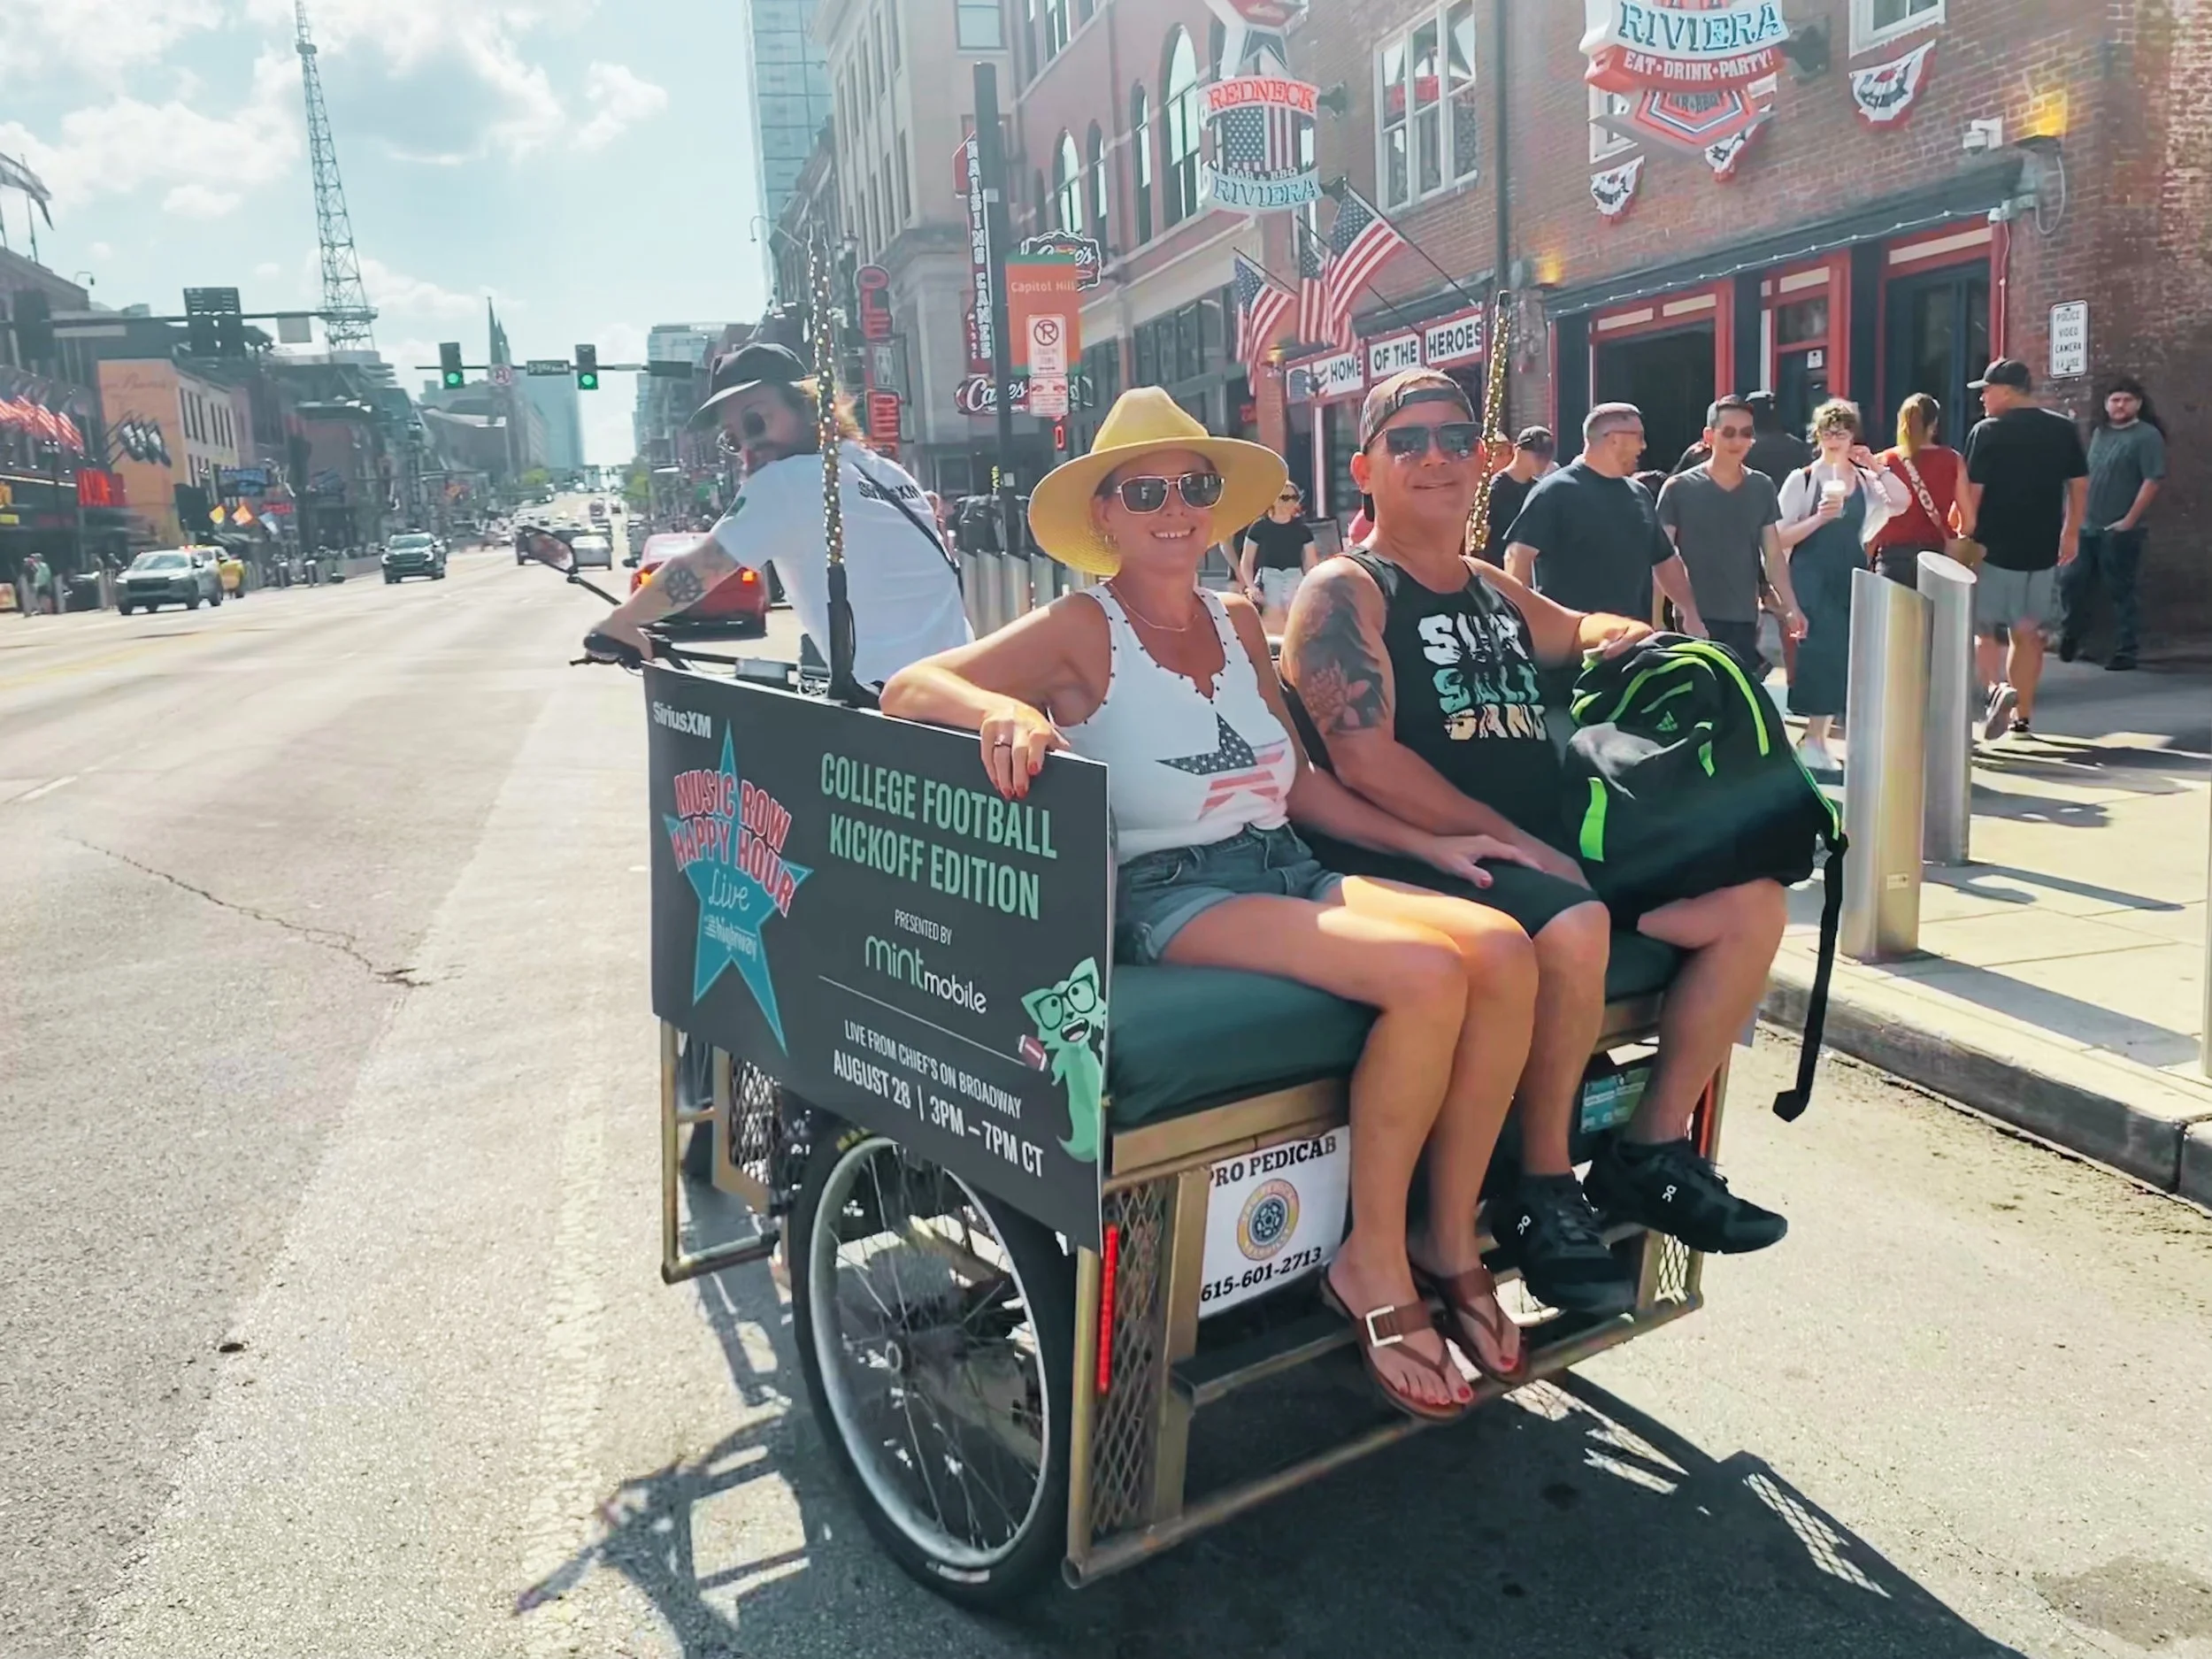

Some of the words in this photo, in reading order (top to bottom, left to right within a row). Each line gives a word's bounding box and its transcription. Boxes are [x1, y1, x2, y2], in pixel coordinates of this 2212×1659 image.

[1618, 2, 1781, 51] RIVIERA
[1623, 50, 1656, 75] EAT
[1663, 60, 1714, 81] DRINK
[1719, 50, 1774, 78] PARTY!
[1208, 80, 1316, 113] REDNECK
[966, 140, 986, 265] RAISING
[1214, 177, 1317, 207] RIVIERA
[1010, 280, 1051, 294] Capitol
[1056, 280, 1075, 292] Hill
[1330, 357, 1362, 383] HOME
[1373, 347, 1389, 372] OF
[1394, 339, 1417, 367] THE
[1427, 320, 1483, 358] HEROES
[2055, 342, 2082, 354] CAMERA
[653, 701, 711, 739] SiriusXM
[674, 769, 736, 819] MUSIC
[740, 779, 793, 854] ROW
[821, 752, 917, 820] COLLEGE
[923, 779, 1057, 859] FOOTBALL
[670, 817, 733, 873] HAPPY
[734, 825, 797, 918] HOUR
[708, 868, 750, 911] Live
[829, 813, 925, 882] KICKOFF
[930, 843, 1040, 920] EDITION
[895, 909, 939, 941] PRESENTED
[940, 926, 953, 945] BY
[844, 1019, 866, 1048] LIVE
[867, 1030, 896, 1061] FROM
[898, 1042, 938, 1080] CHIEF'S
[940, 1064, 956, 1089] ON
[958, 1071, 1022, 1118] BROADWAY
[833, 1049, 889, 1098] AUGUST
[892, 1075, 911, 1110] 28
[930, 1094, 964, 1137] 3PM
[981, 1120, 1018, 1165] 7PM
[1022, 1141, 1044, 1178] CT
[1248, 1135, 1337, 1178] PEDICAB
[1201, 1246, 1322, 1302] 615-601-2713
